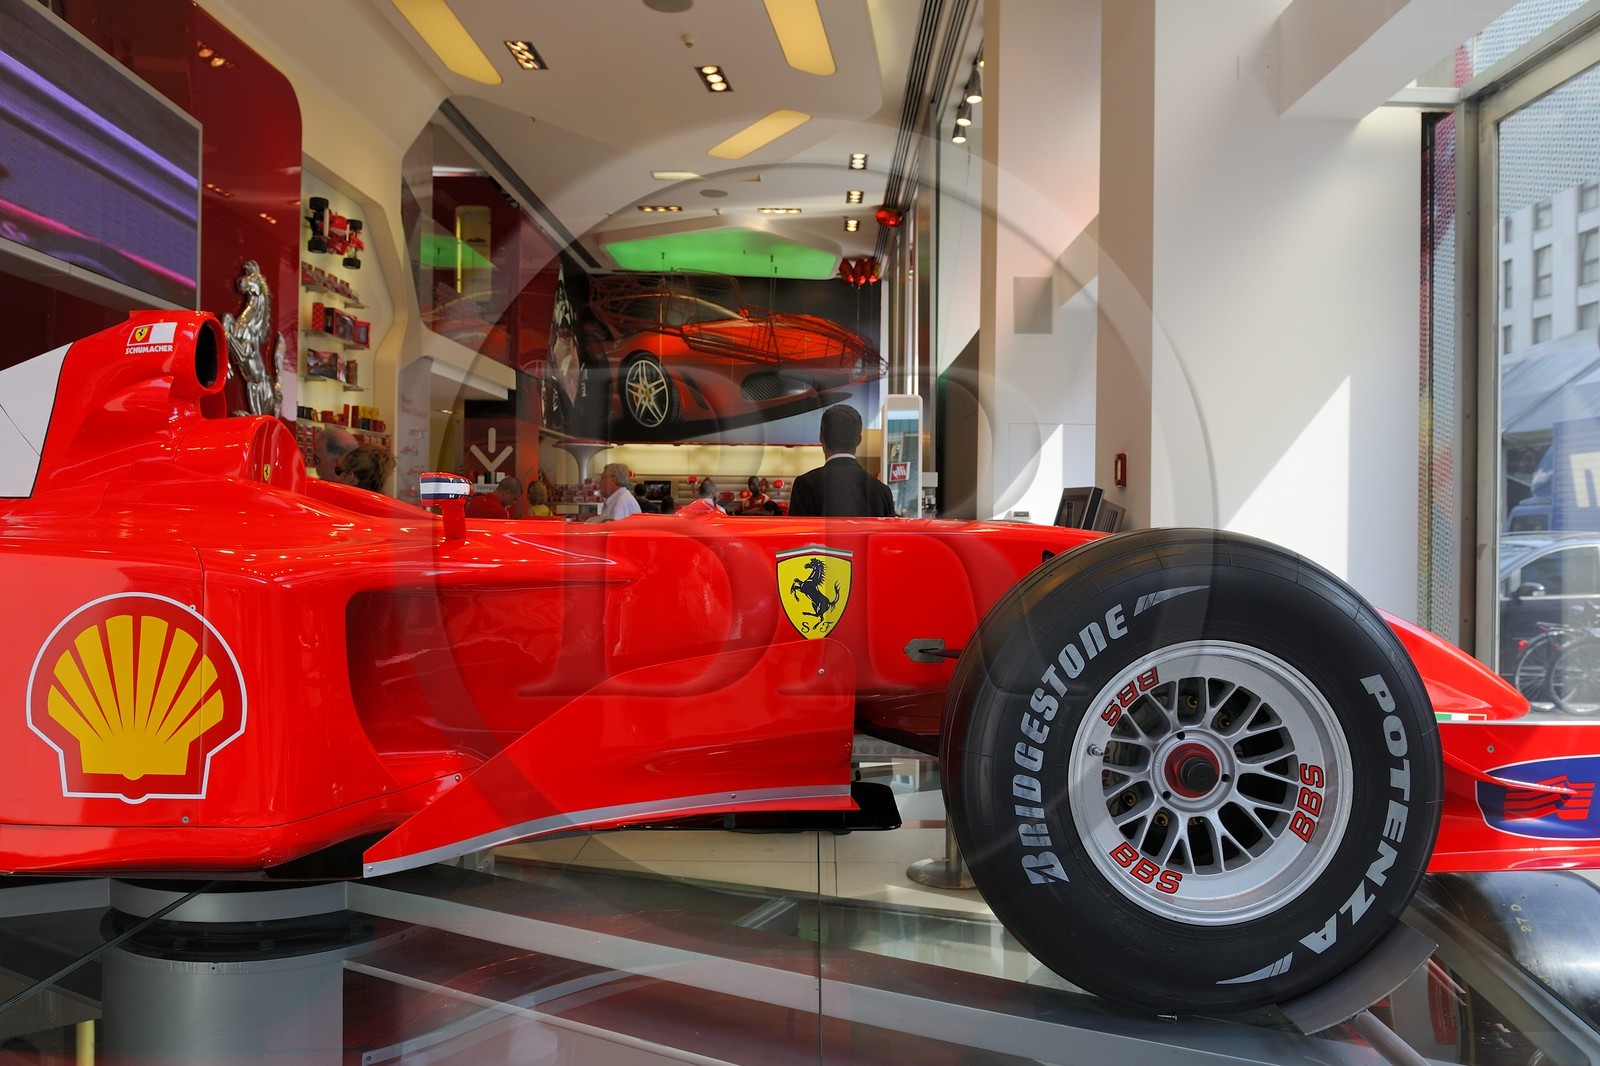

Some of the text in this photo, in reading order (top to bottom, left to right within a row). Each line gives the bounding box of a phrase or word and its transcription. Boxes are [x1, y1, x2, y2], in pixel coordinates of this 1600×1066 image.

[125, 345, 173, 355] SCHUMACHER
[801, 621, 810, 633] S
[1100, 666, 1160, 727] BBS
[1011, 603, 1130, 886] BRIDGESTONE
[1289, 762, 1324, 843] BBS
[1299, 673, 1412, 955] POTENZA
[1109, 841, 1183, 894] BBS
